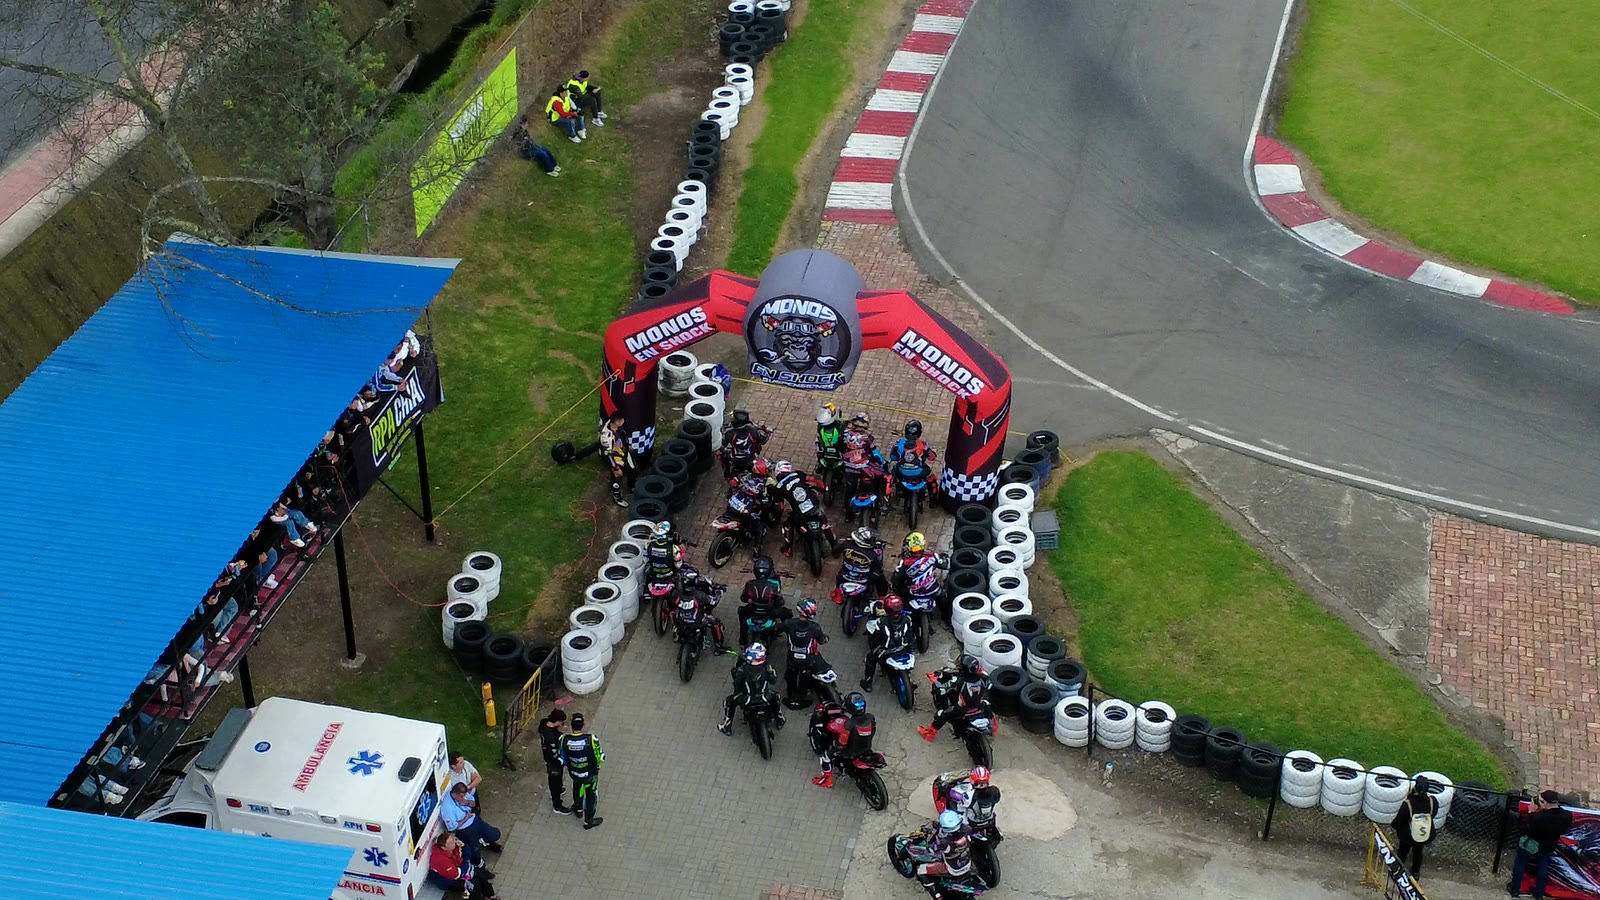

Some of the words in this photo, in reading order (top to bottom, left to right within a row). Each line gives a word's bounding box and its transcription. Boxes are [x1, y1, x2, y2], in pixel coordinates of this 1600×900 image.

[625, 306, 707, 353] MONOS
[760, 299, 837, 321] MONOS
[633, 347, 660, 363] EN
[659, 322, 716, 350] SHOCK
[900, 329, 985, 395] MONOS
[751, 363, 777, 379] EN
[778, 370, 846, 385] SHOCK
[892, 342, 916, 360] EN
[916, 359, 971, 400] SHOCK
[292, 722, 344, 793] AMBULANCIA
